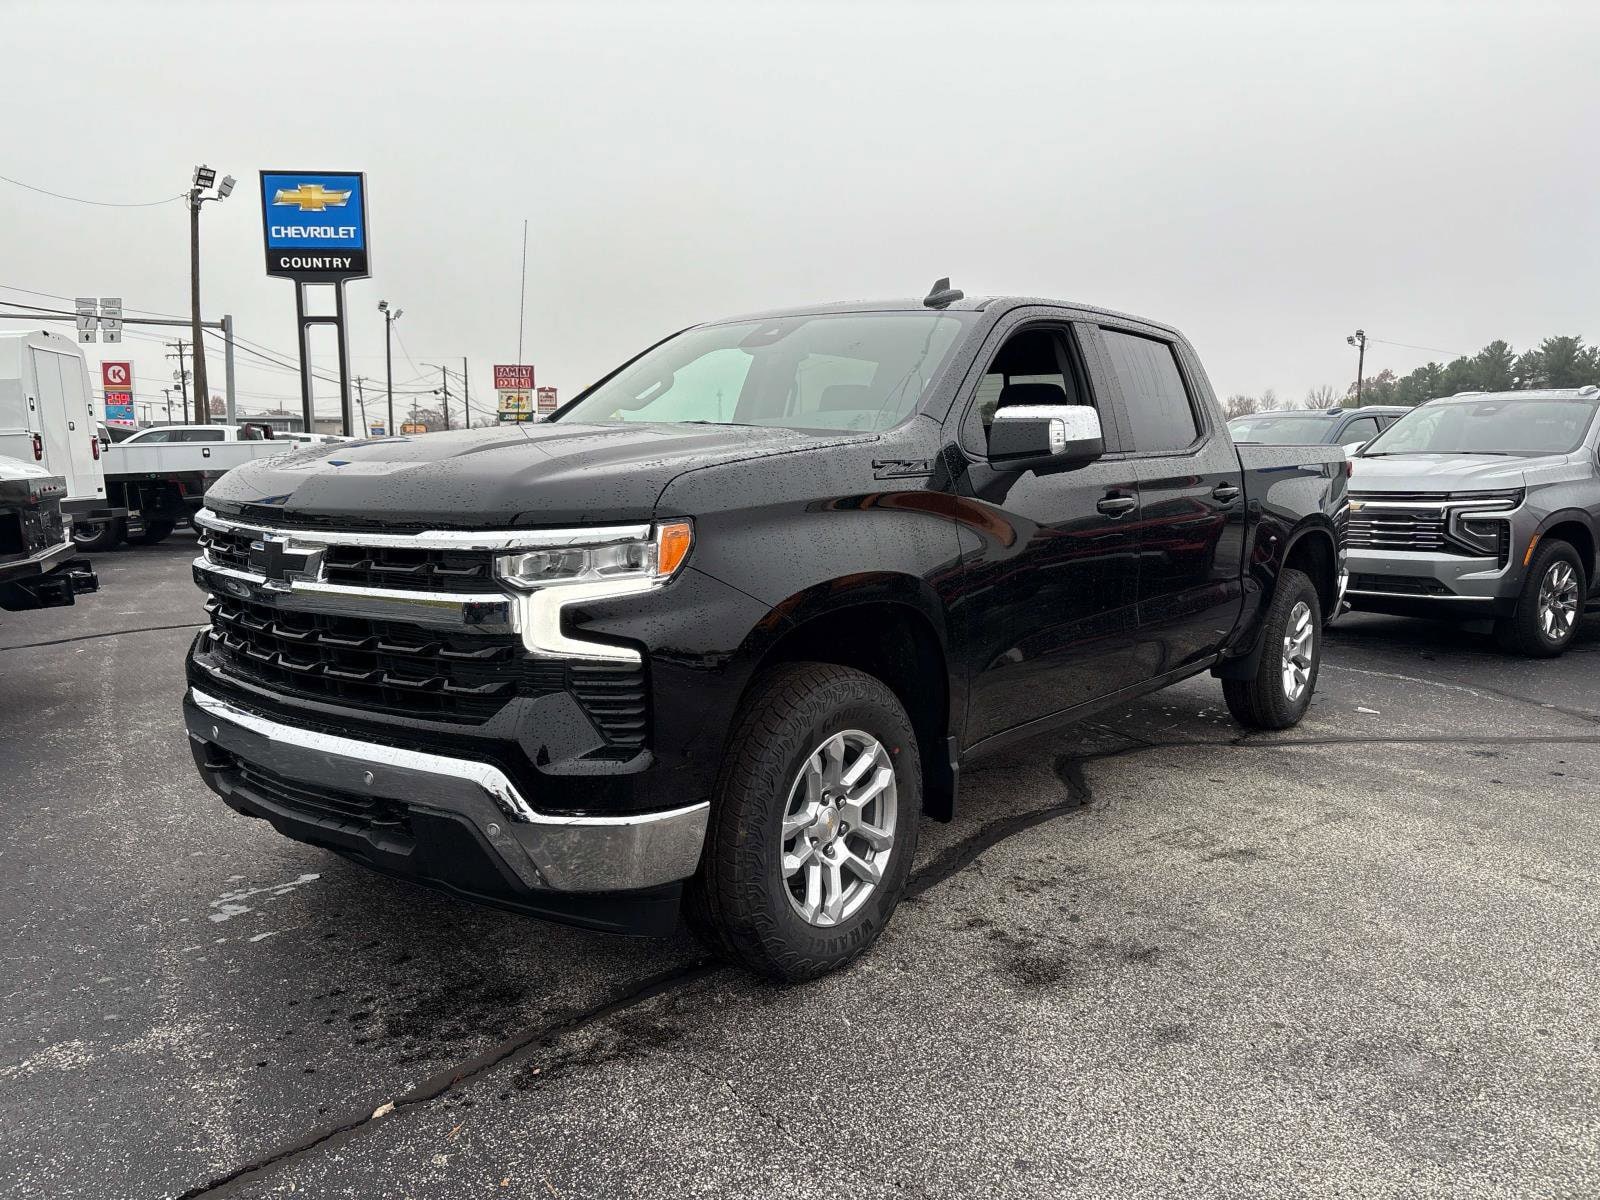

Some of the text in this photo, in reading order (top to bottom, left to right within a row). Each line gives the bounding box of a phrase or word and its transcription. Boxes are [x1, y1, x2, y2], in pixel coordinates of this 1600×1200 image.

[271, 226, 356, 238] CHEVROLET
[280, 257, 351, 268] COUNTRY
[112, 369, 124, 381] K
